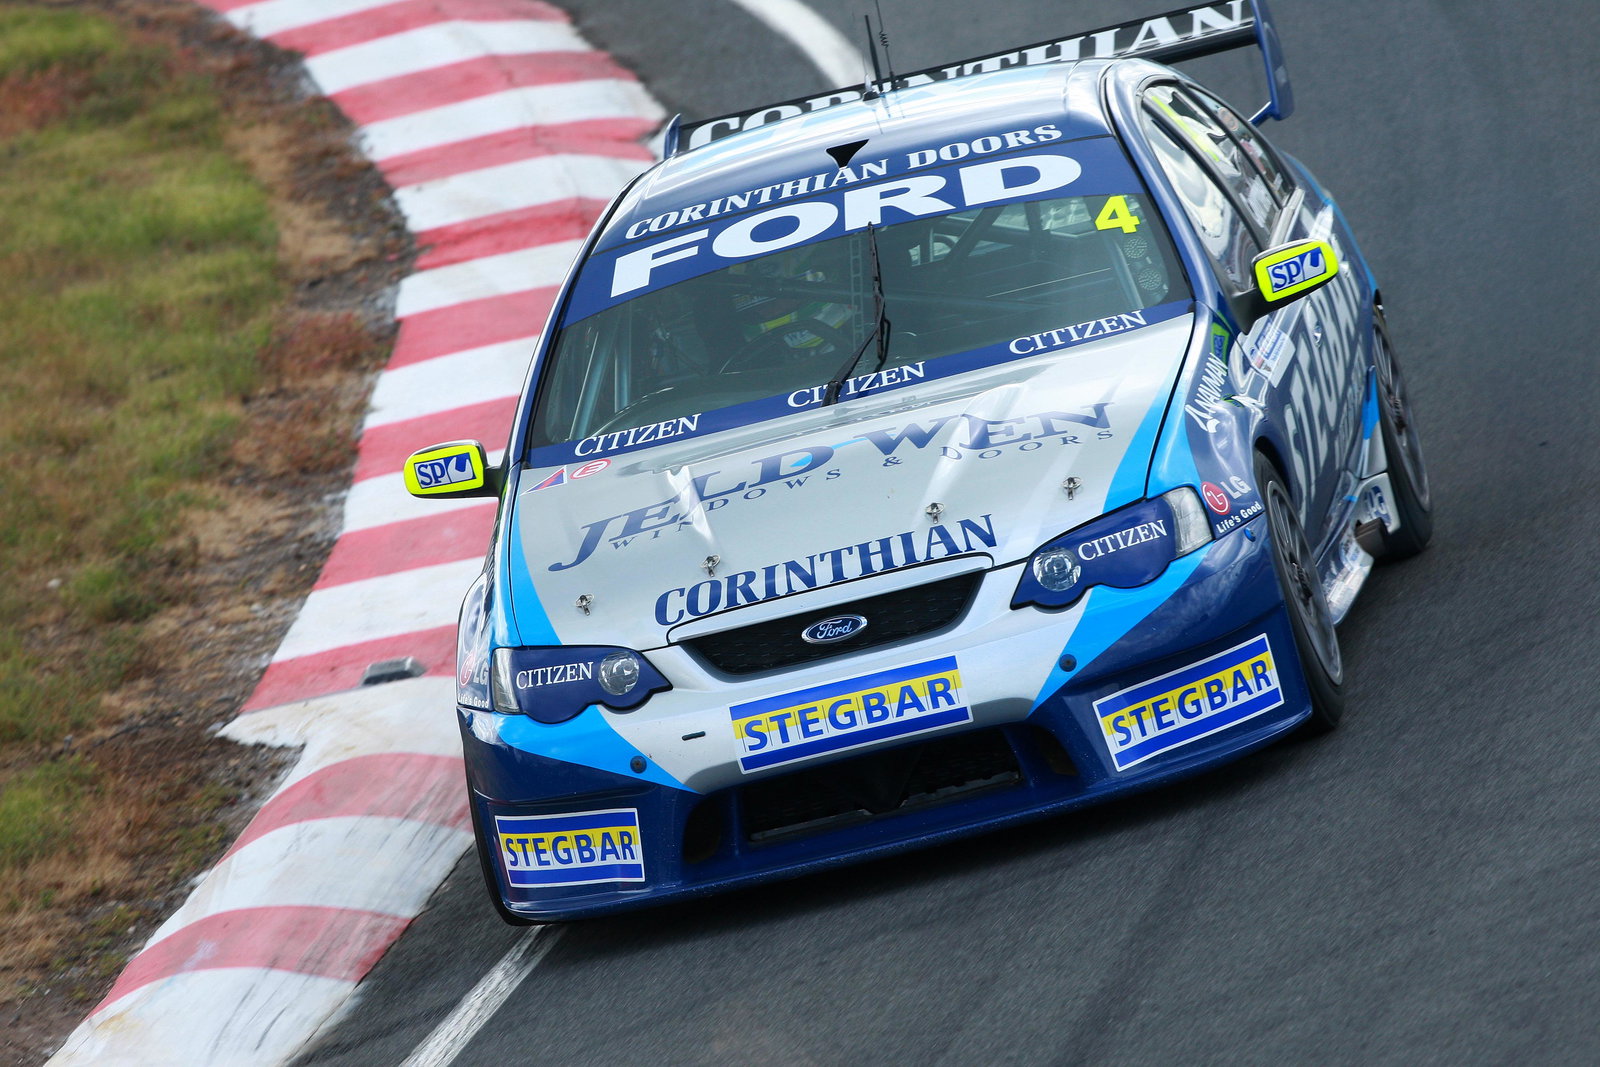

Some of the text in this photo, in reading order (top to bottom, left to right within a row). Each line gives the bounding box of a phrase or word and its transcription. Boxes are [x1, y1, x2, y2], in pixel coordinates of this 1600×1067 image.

[625, 125, 1062, 241] CORINTHIAN DOORS
[610, 154, 1082, 298] FORD
[1094, 195, 1141, 233] 4
[1008, 310, 1148, 356] CITIZEN
[787, 361, 926, 407] CIIZEN
[574, 413, 702, 457] CITIZEN
[882, 456, 903, 467] &
[939, 430, 1113, 460] DOORS
[1220, 475, 1252, 499] LG
[1216, 501, 1262, 534] Life's Good
[1078, 520, 1168, 561] CITIZEN
[654, 514, 998, 626] CORINTHIAN
[817, 620, 853, 640] Ford
[515, 661, 594, 690] CITIZEN
[744, 677, 956, 751] STEGBAR
[1111, 659, 1272, 746] STEGBAR
[505, 830, 636, 867] STEGBAR
